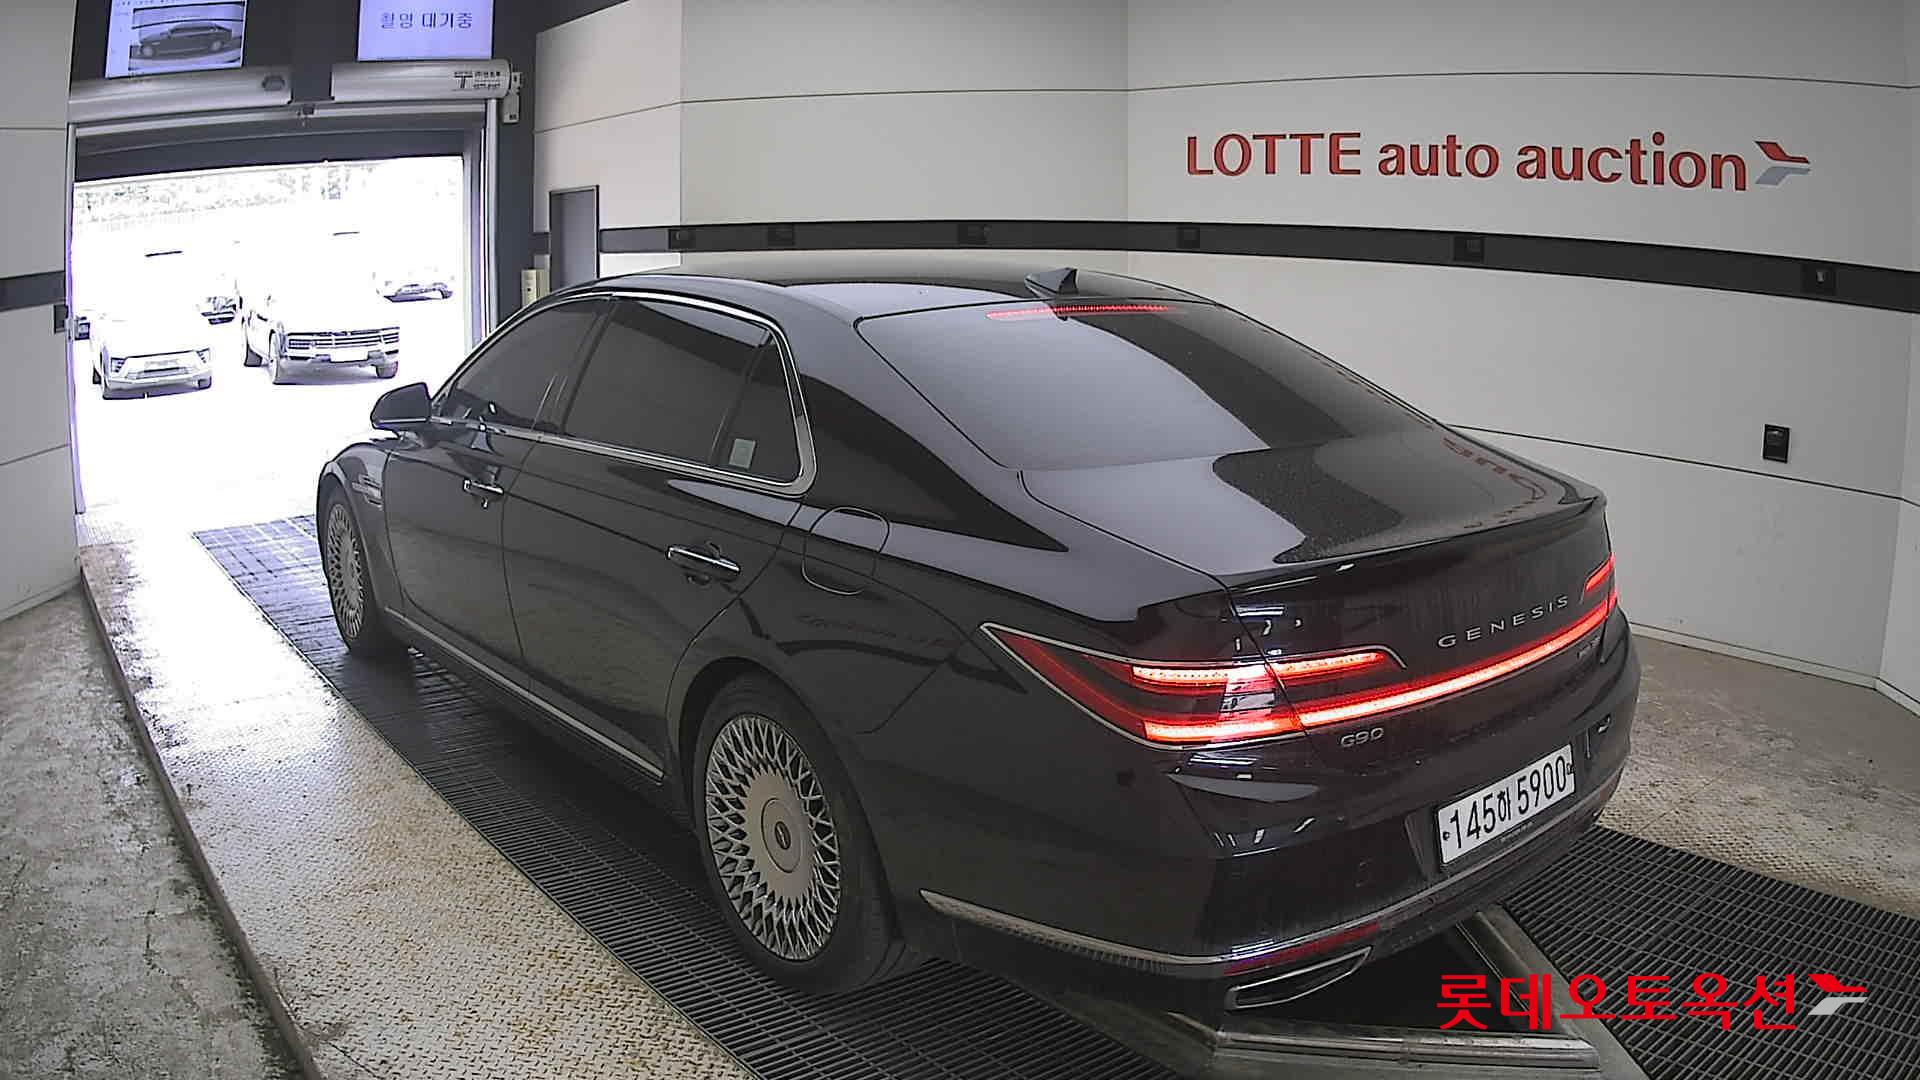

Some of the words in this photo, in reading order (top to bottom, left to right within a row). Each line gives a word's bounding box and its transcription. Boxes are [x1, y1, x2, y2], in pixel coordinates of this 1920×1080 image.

[422, 12, 473, 29] 대기중
[1186, 132, 1362, 176] LOTTE
[1378, 135, 1500, 178] auto
[1516, 132, 1748, 191] auction
[1437, 595, 1568, 648] GENESIS
[1340, 727, 1385, 748] G90
